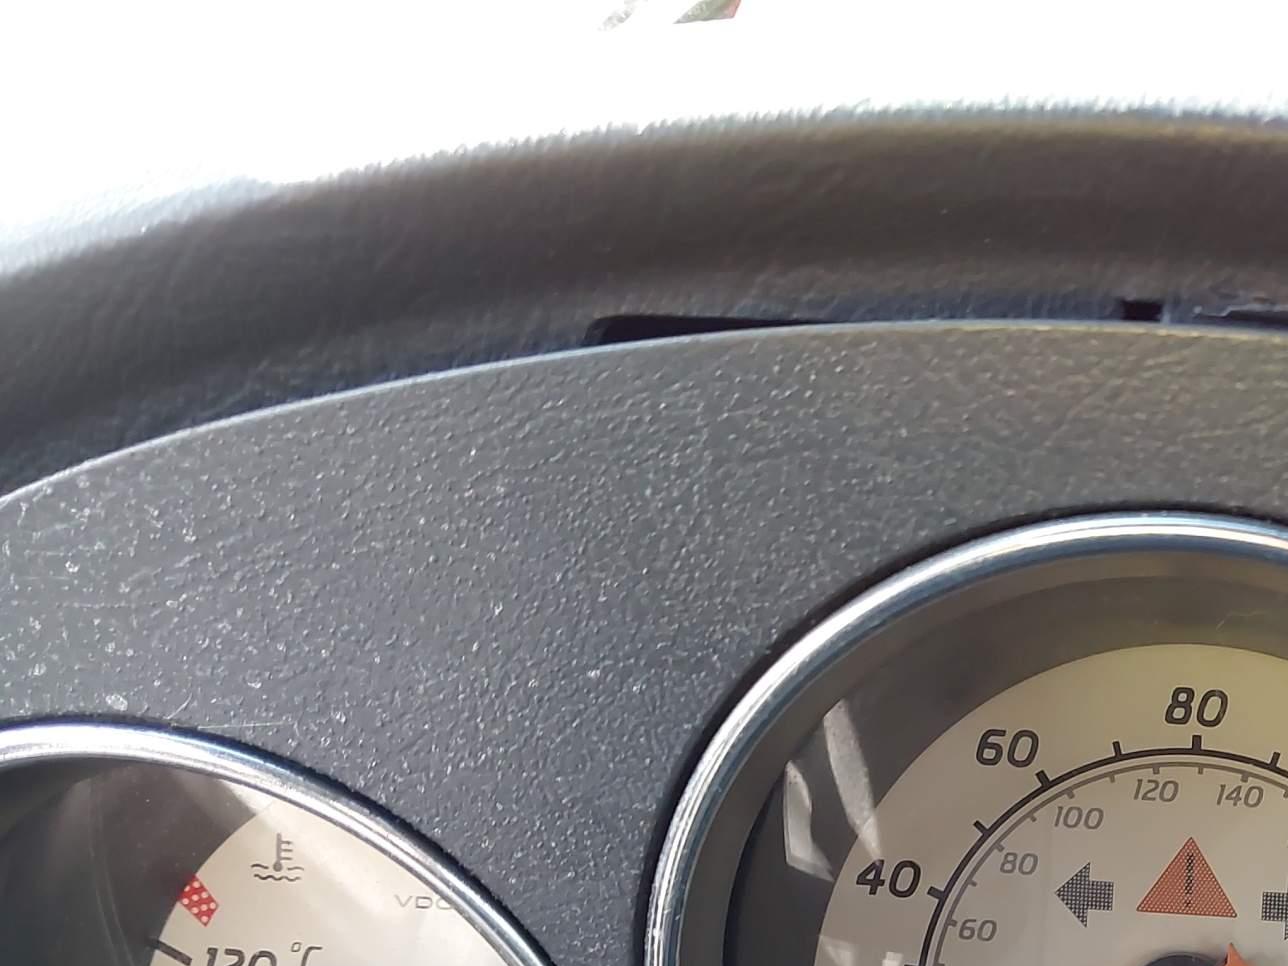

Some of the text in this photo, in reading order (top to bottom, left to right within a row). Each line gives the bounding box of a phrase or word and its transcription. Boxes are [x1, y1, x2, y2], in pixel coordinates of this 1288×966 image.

[1164, 687, 1228, 727] 80
[976, 729, 1039, 768] 60
[1133, 779, 1179, 802] 120
[1216, 784, 1263, 808] 140
[1054, 806, 1103, 829] 100
[1000, 852, 1038, 875] 80
[856, 859, 922, 898] 40
[958, 919, 997, 941] 60
